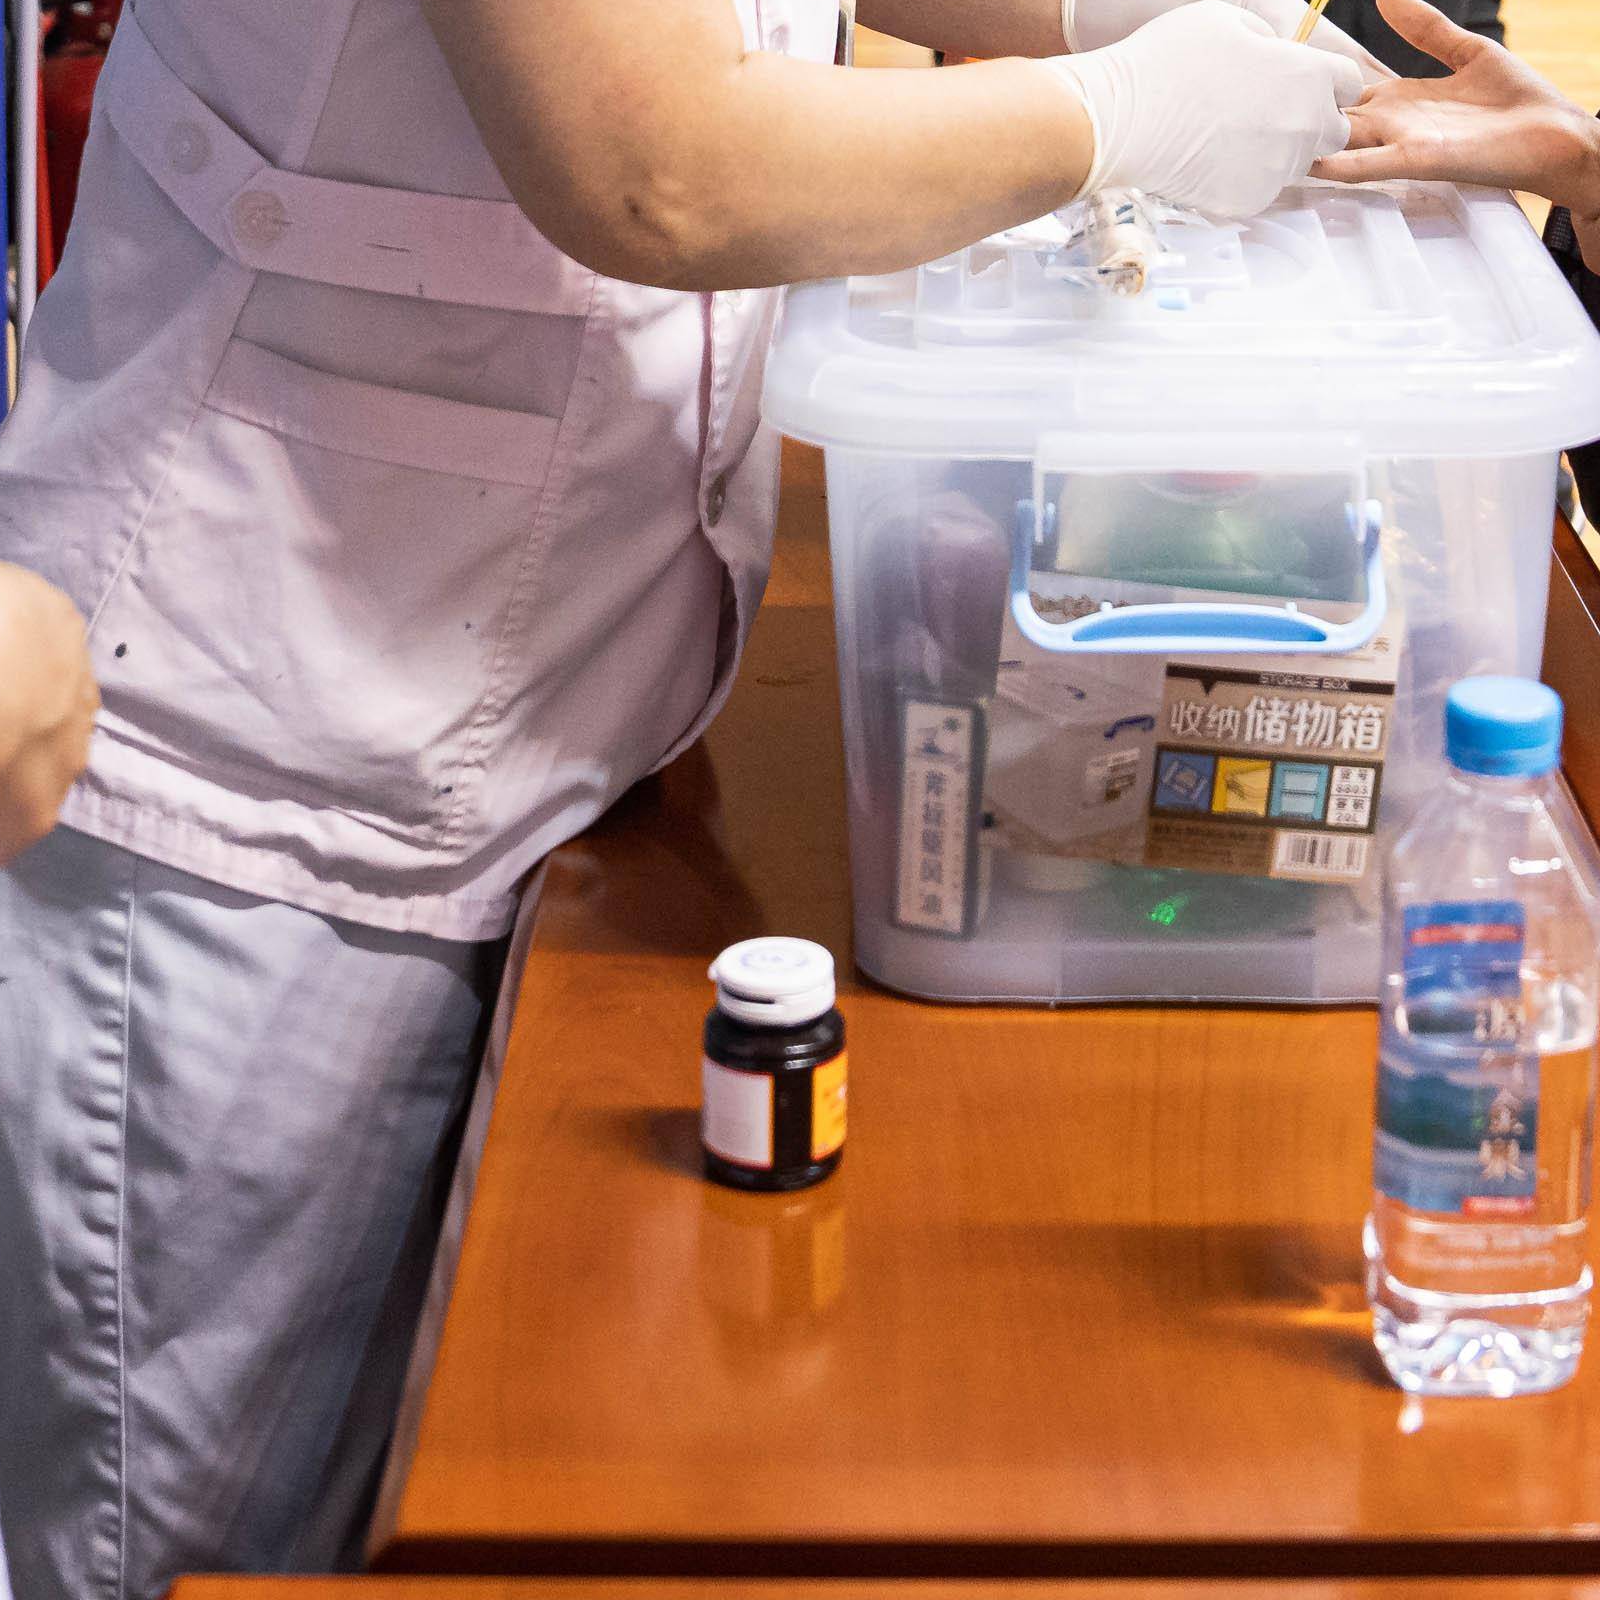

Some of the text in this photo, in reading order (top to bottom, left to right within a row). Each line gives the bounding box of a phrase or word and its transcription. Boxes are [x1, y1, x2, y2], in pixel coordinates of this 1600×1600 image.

[1260, 672, 1350, 691] STORAGE BOX
[1169, 695, 1385, 751] 收纳储物箱
